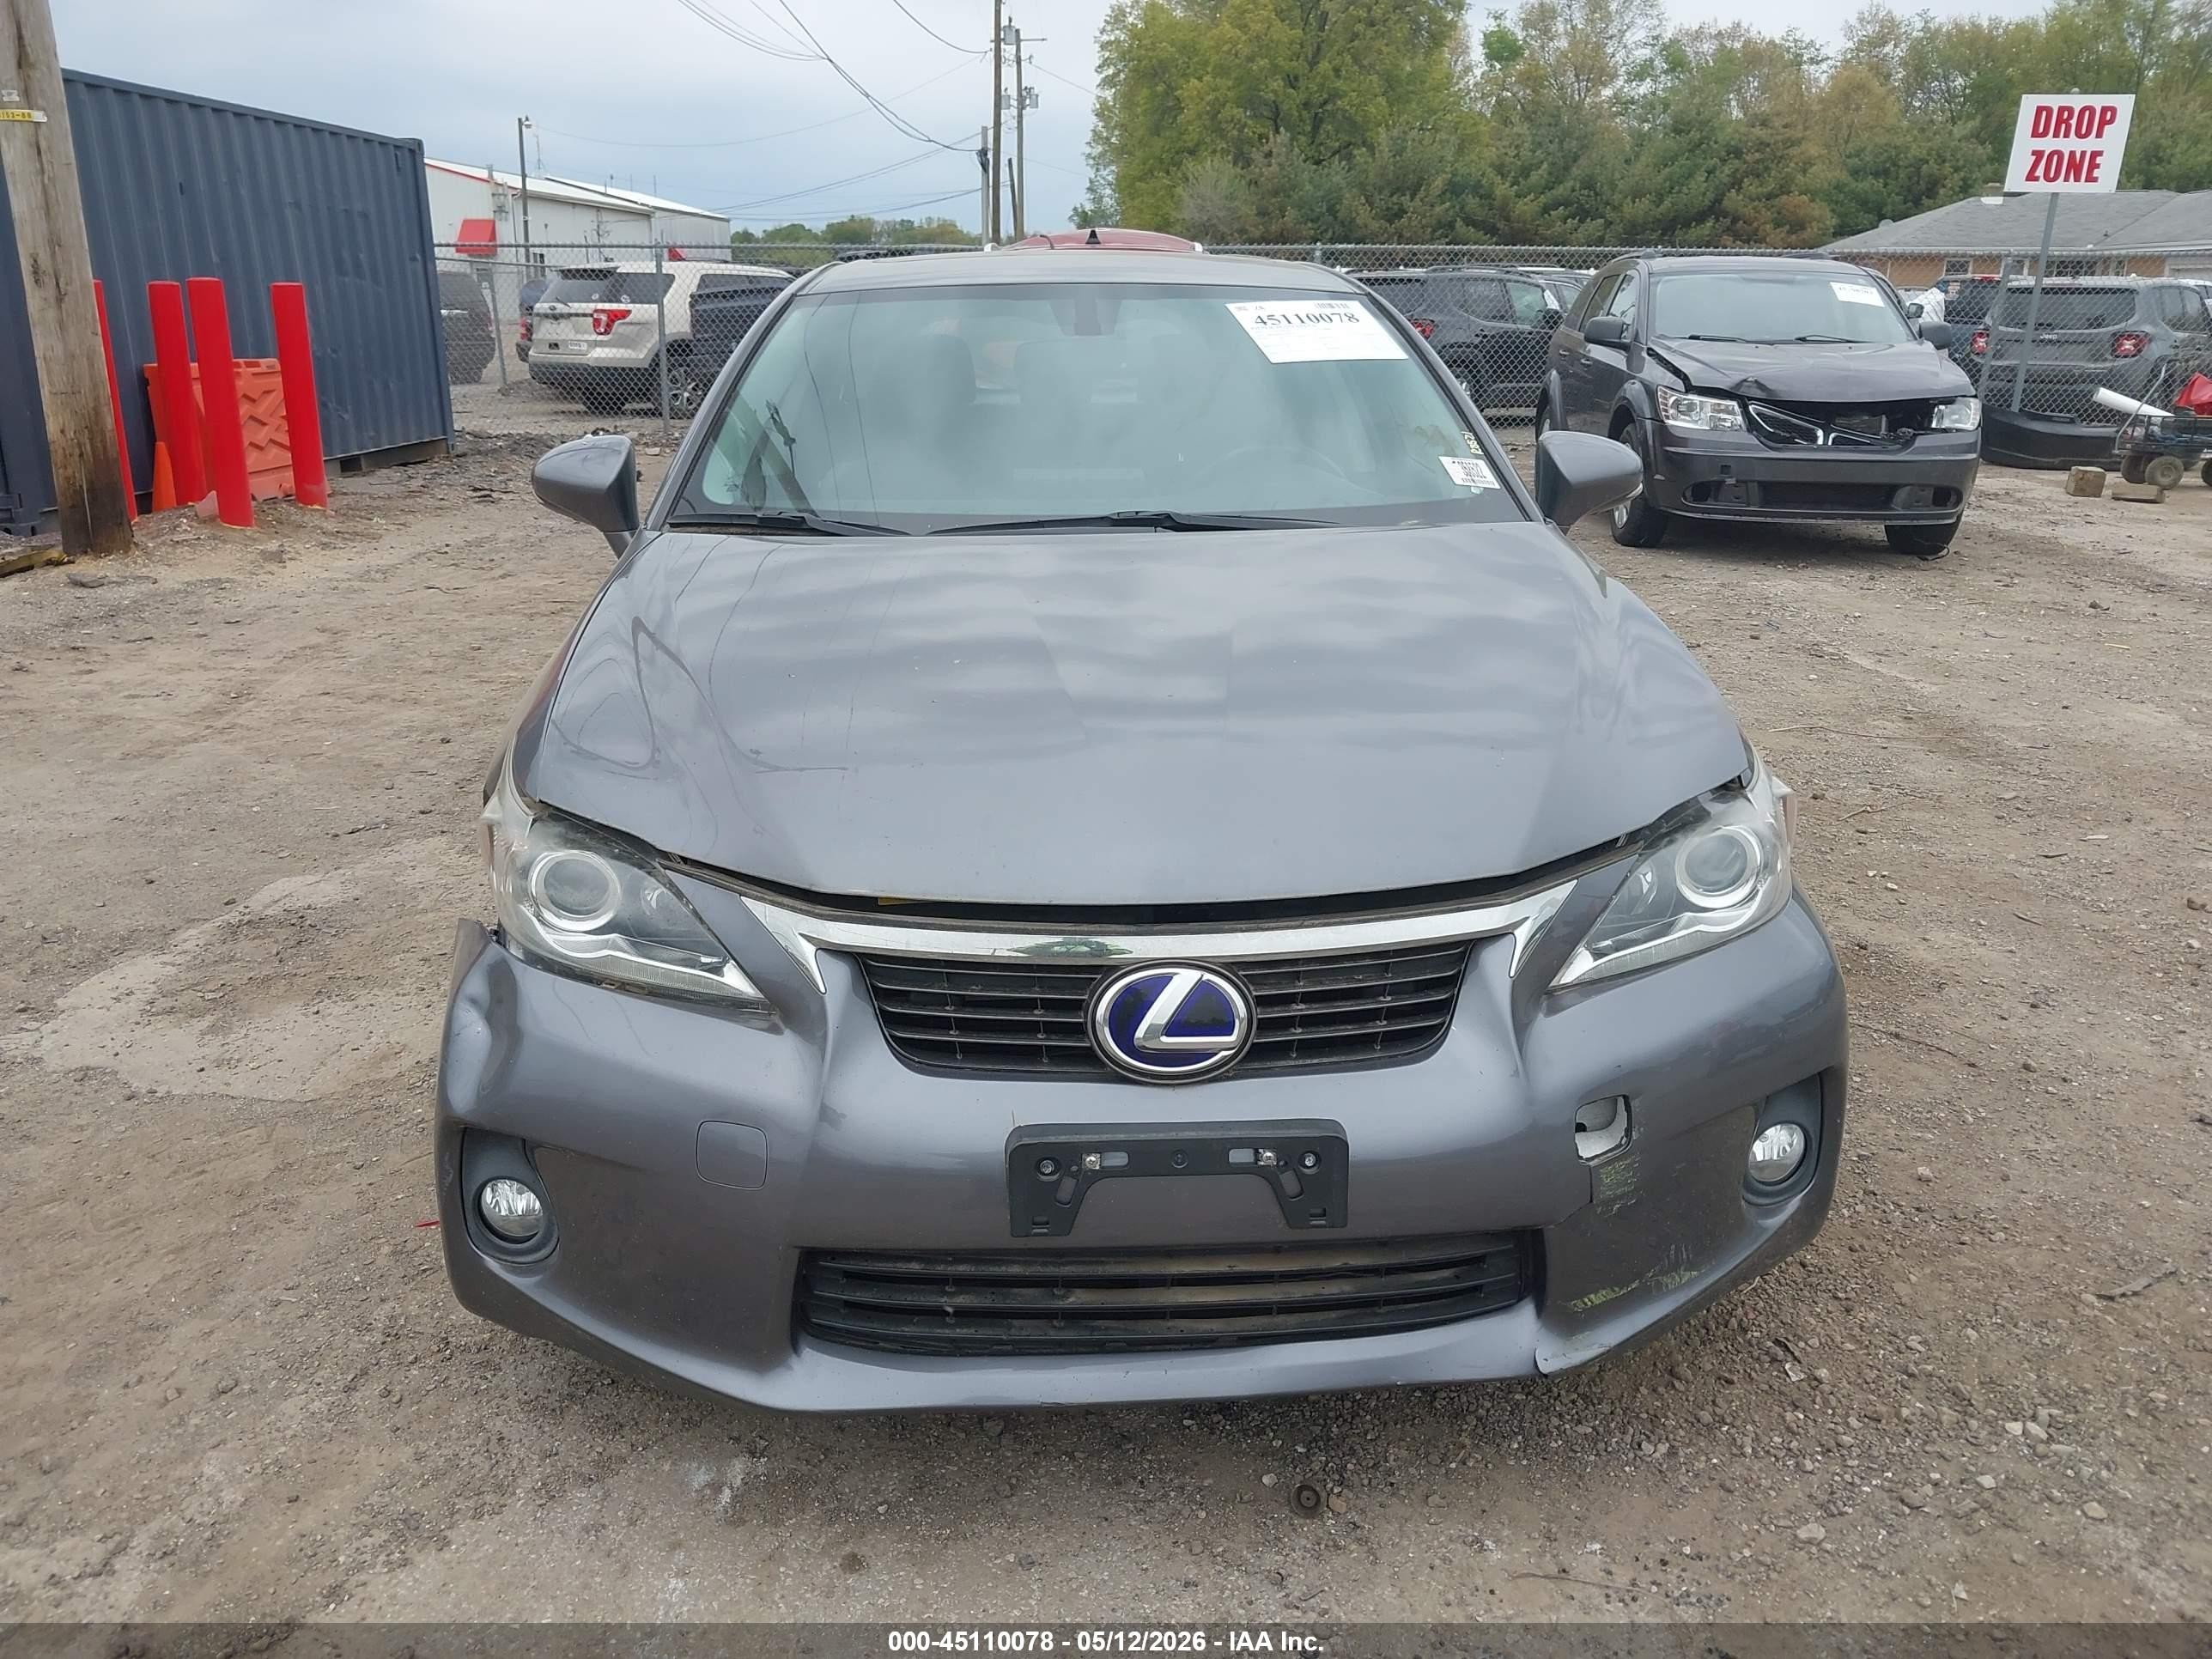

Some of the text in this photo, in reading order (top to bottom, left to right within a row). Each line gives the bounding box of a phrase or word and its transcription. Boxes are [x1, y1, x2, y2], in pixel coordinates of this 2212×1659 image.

[2030, 105, 2118, 140] DROP
[2025, 149, 2105, 183] ZONE
[1255, 312, 1360, 326] 45110078
